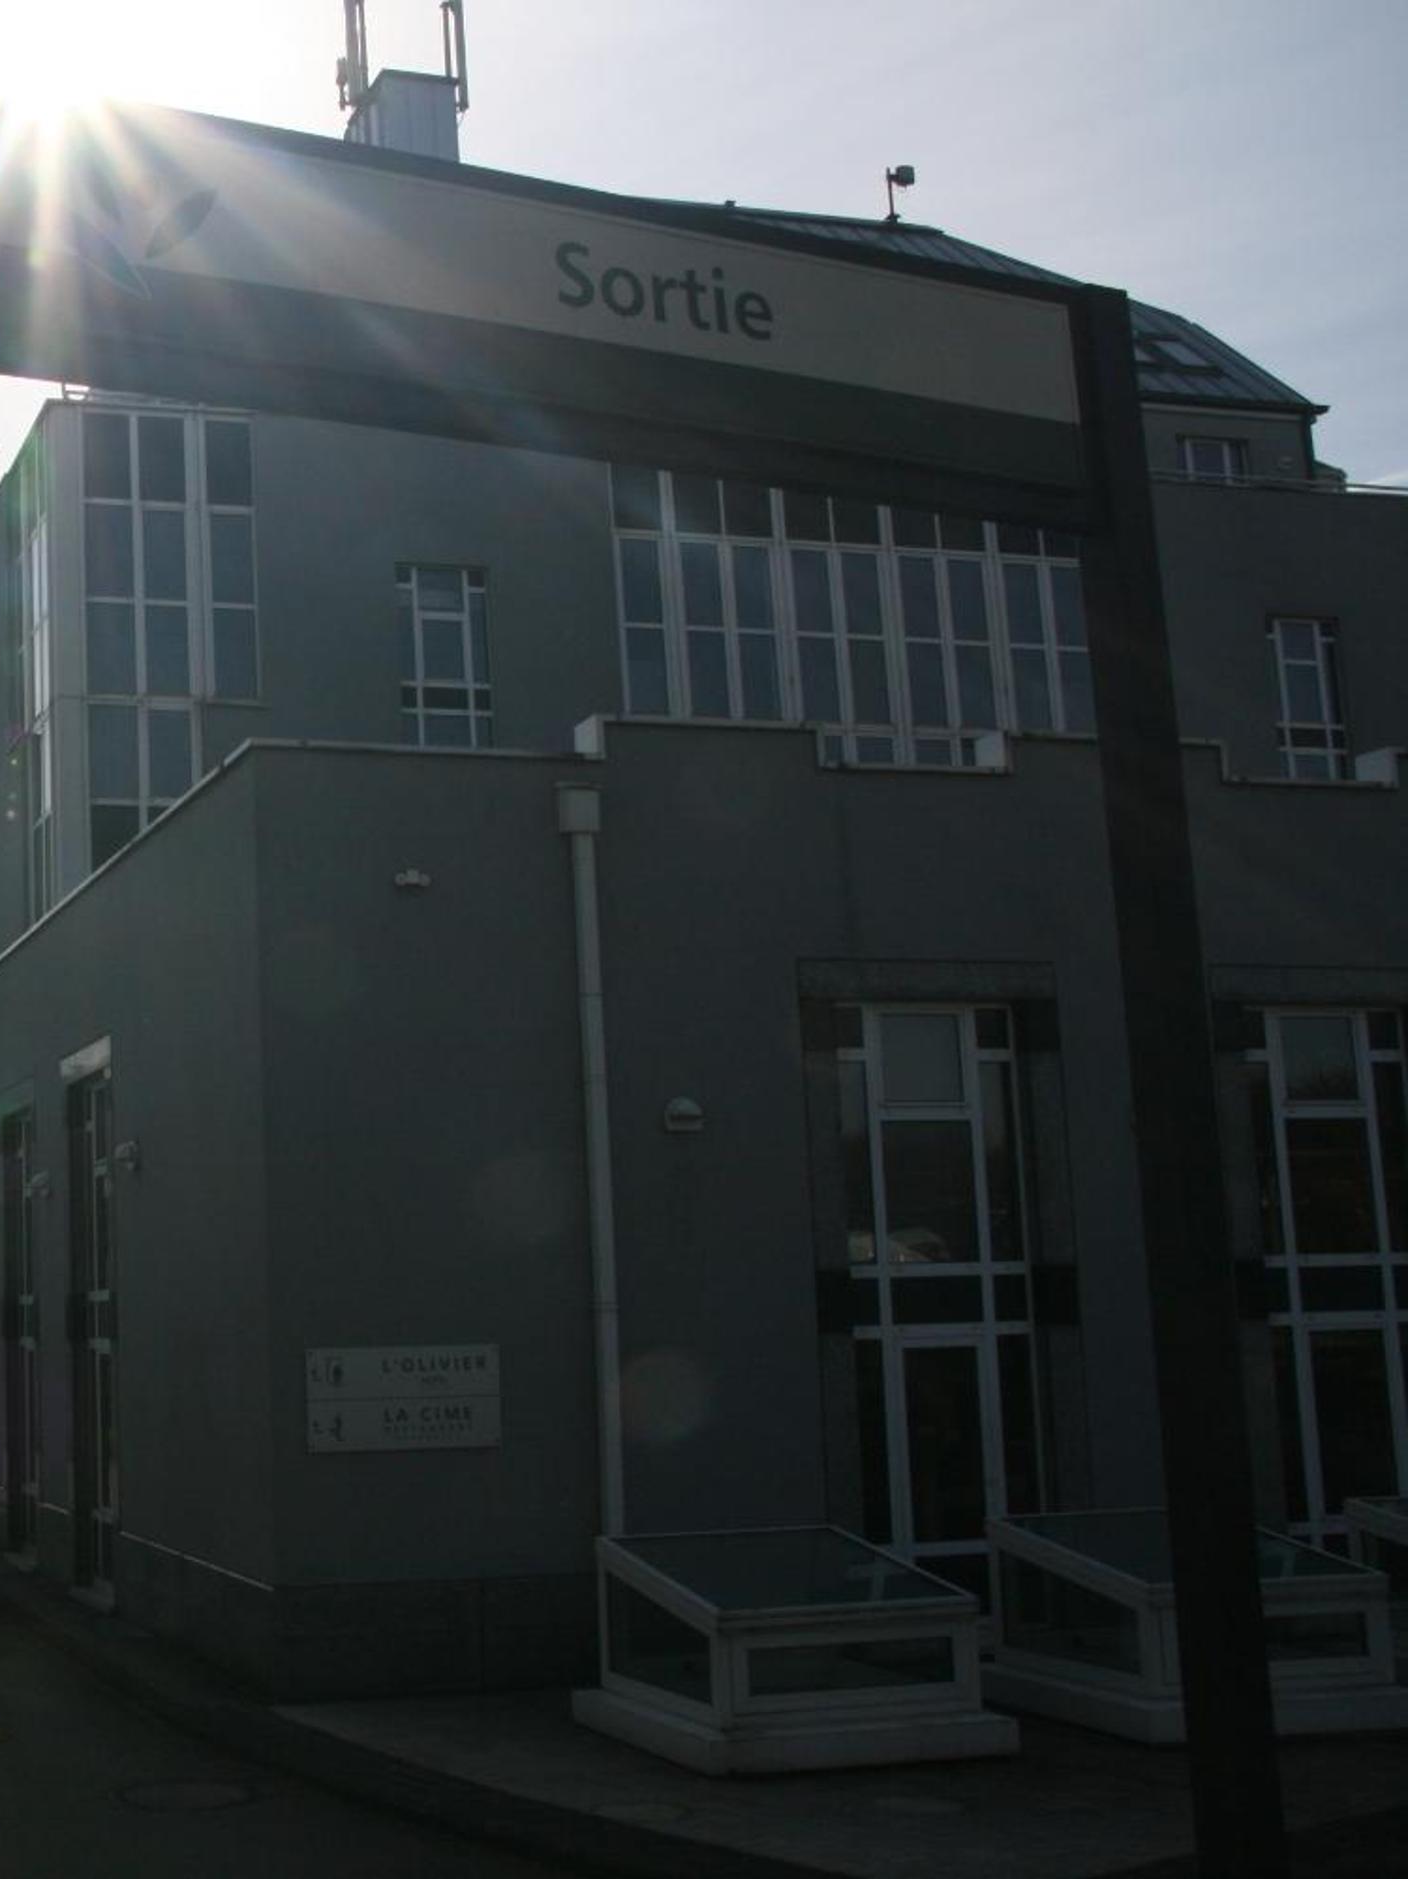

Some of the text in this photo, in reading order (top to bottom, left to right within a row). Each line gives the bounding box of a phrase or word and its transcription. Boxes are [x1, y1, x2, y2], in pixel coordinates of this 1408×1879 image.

[556, 241, 773, 340] Sortie
[382, 1355, 486, 1373] L'OLIVIER
[383, 1405, 472, 1422] LA CIME
